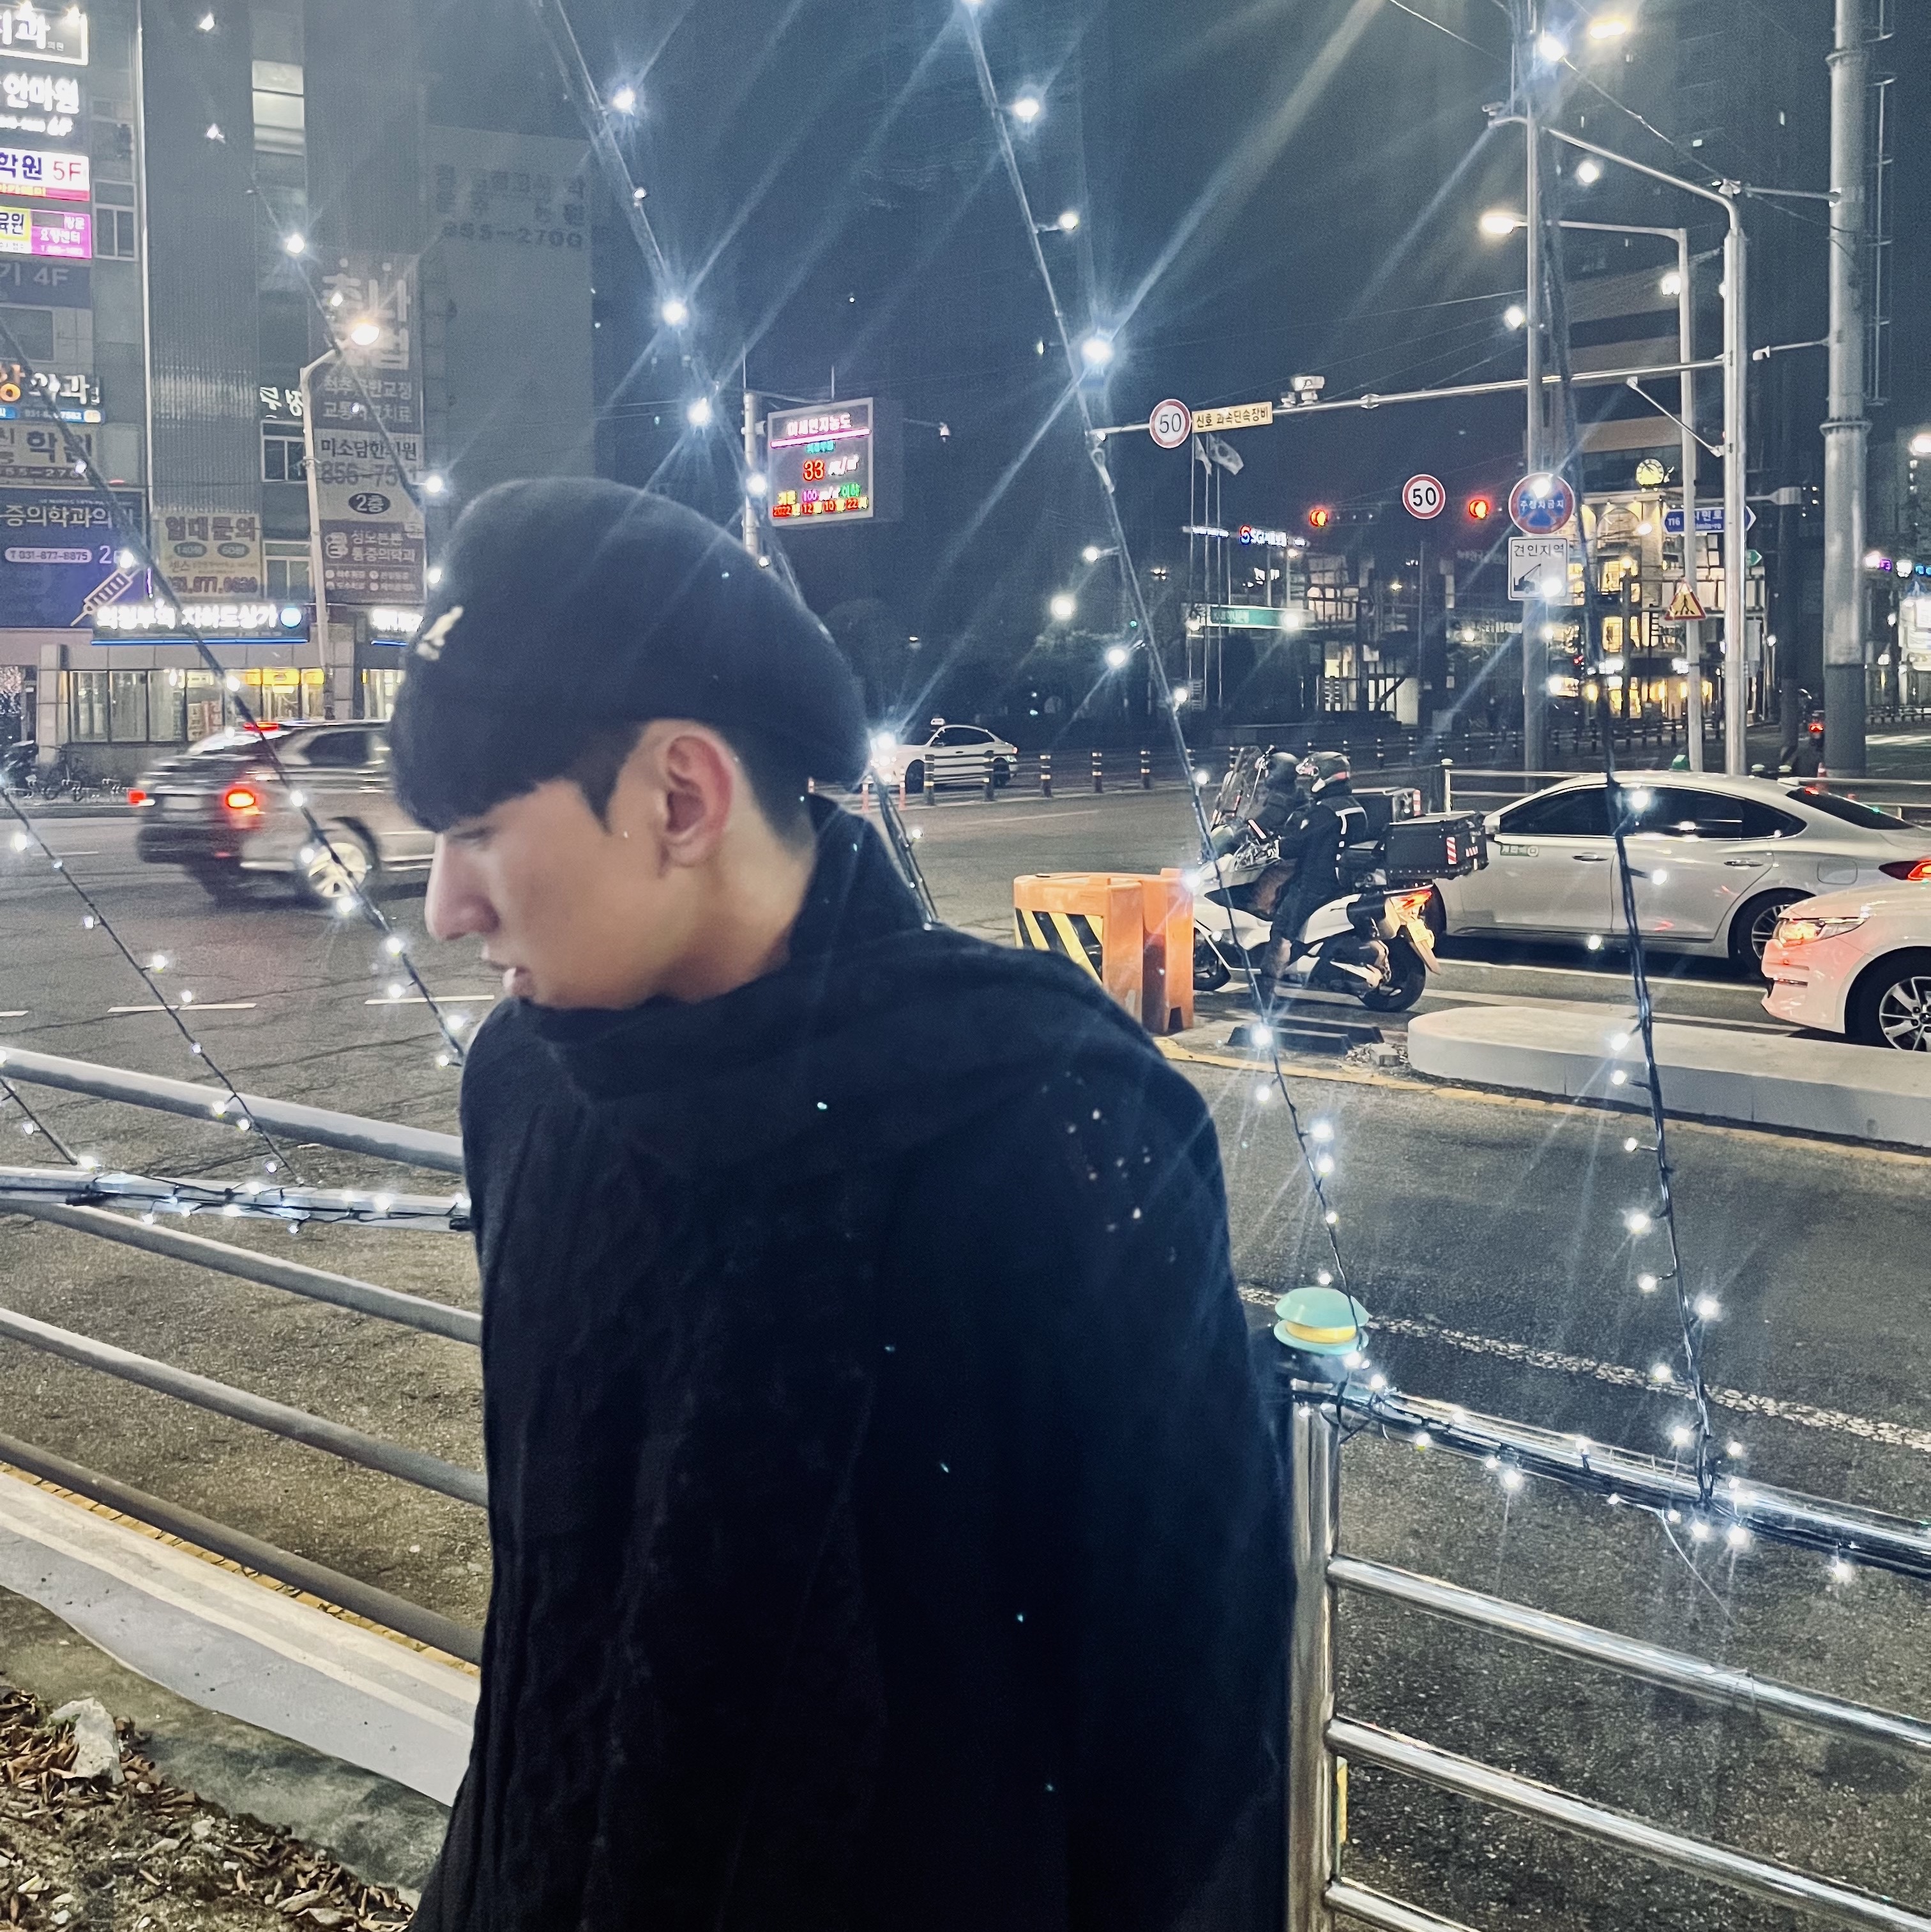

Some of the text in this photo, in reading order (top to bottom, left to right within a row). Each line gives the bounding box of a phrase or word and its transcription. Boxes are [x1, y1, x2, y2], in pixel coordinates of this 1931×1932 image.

[52, 160, 82, 181] 5F
[33, 266, 70, 287] 4F
[1159, 413, 1181, 434] 50
[1197, 413, 1213, 428] 신호
[803, 459, 825, 480] 33
[355, 494, 384, 512] 2층
[1413, 487, 1437, 506] 50
[165, 516, 255, 542] 임대문의
[1514, 544, 1564, 558] 견인지역
[181, 604, 278, 629] 지하도상가
